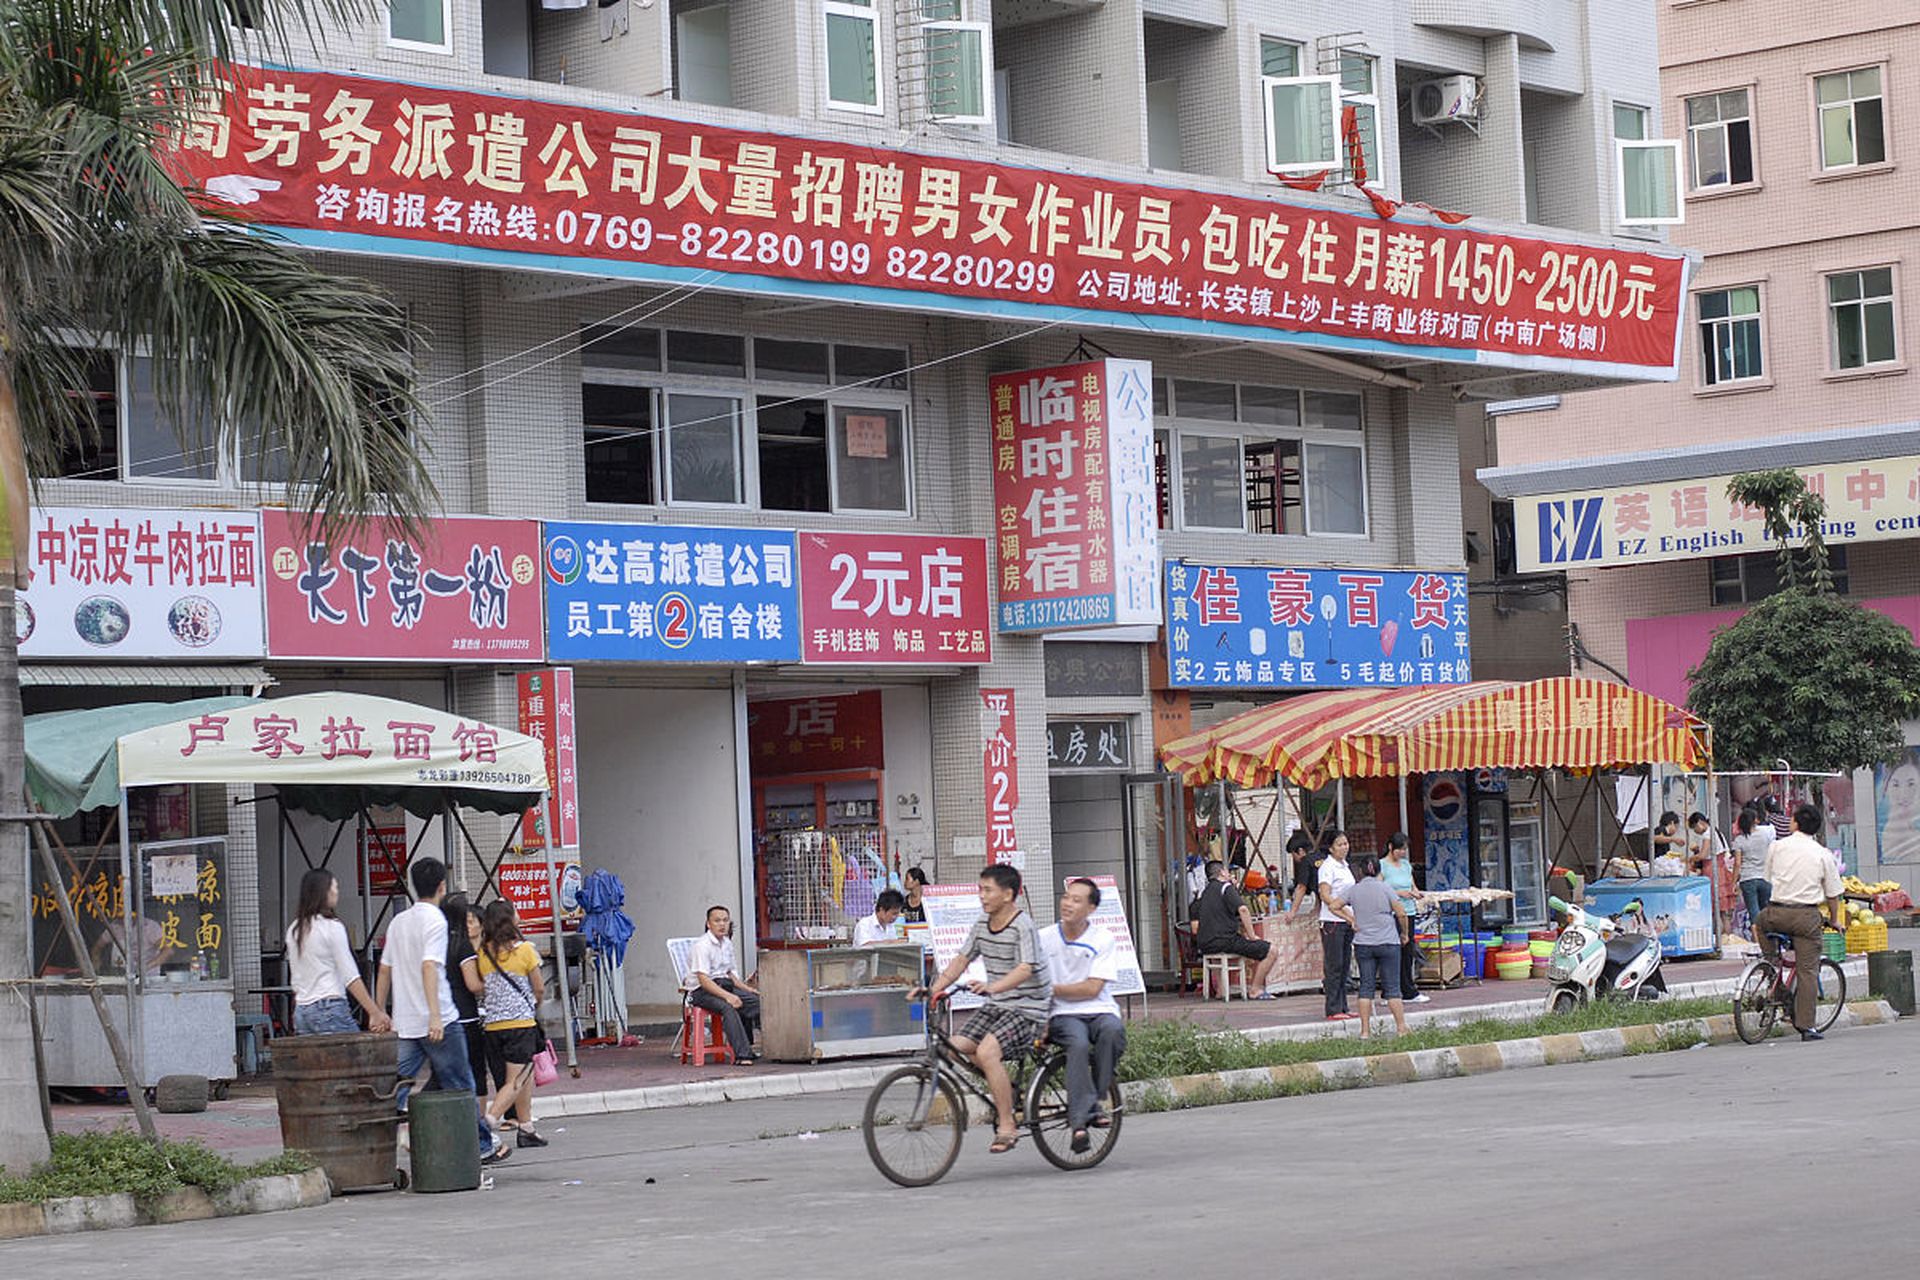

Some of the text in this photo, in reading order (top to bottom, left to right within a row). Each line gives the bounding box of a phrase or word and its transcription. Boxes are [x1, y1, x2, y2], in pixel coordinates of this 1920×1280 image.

[887, 245, 1055, 295] 82280299
[1017, 375, 1082, 592] 临时住宿
[1081, 371, 1109, 585] 电视房配有热水器
[28, 516, 256, 588] 中凉皮牛肉拉面
[585, 538, 793, 589] 达高派遣公司
[1618, 539, 1647, 557] EZ
[1660, 528, 1744, 554] English
[297, 541, 512, 630] 天下第一粉
[829, 548, 964, 619] 2元店
[1191, 567, 1452, 630] 佳豪百货
[812, 628, 986, 653] 手机挂饰 饰品 工艺品
[1169, 566, 1192, 682] 货真价实
[1451, 574, 1471, 682] 天天平价
[180, 713, 500, 765] 卢家拉面馆
